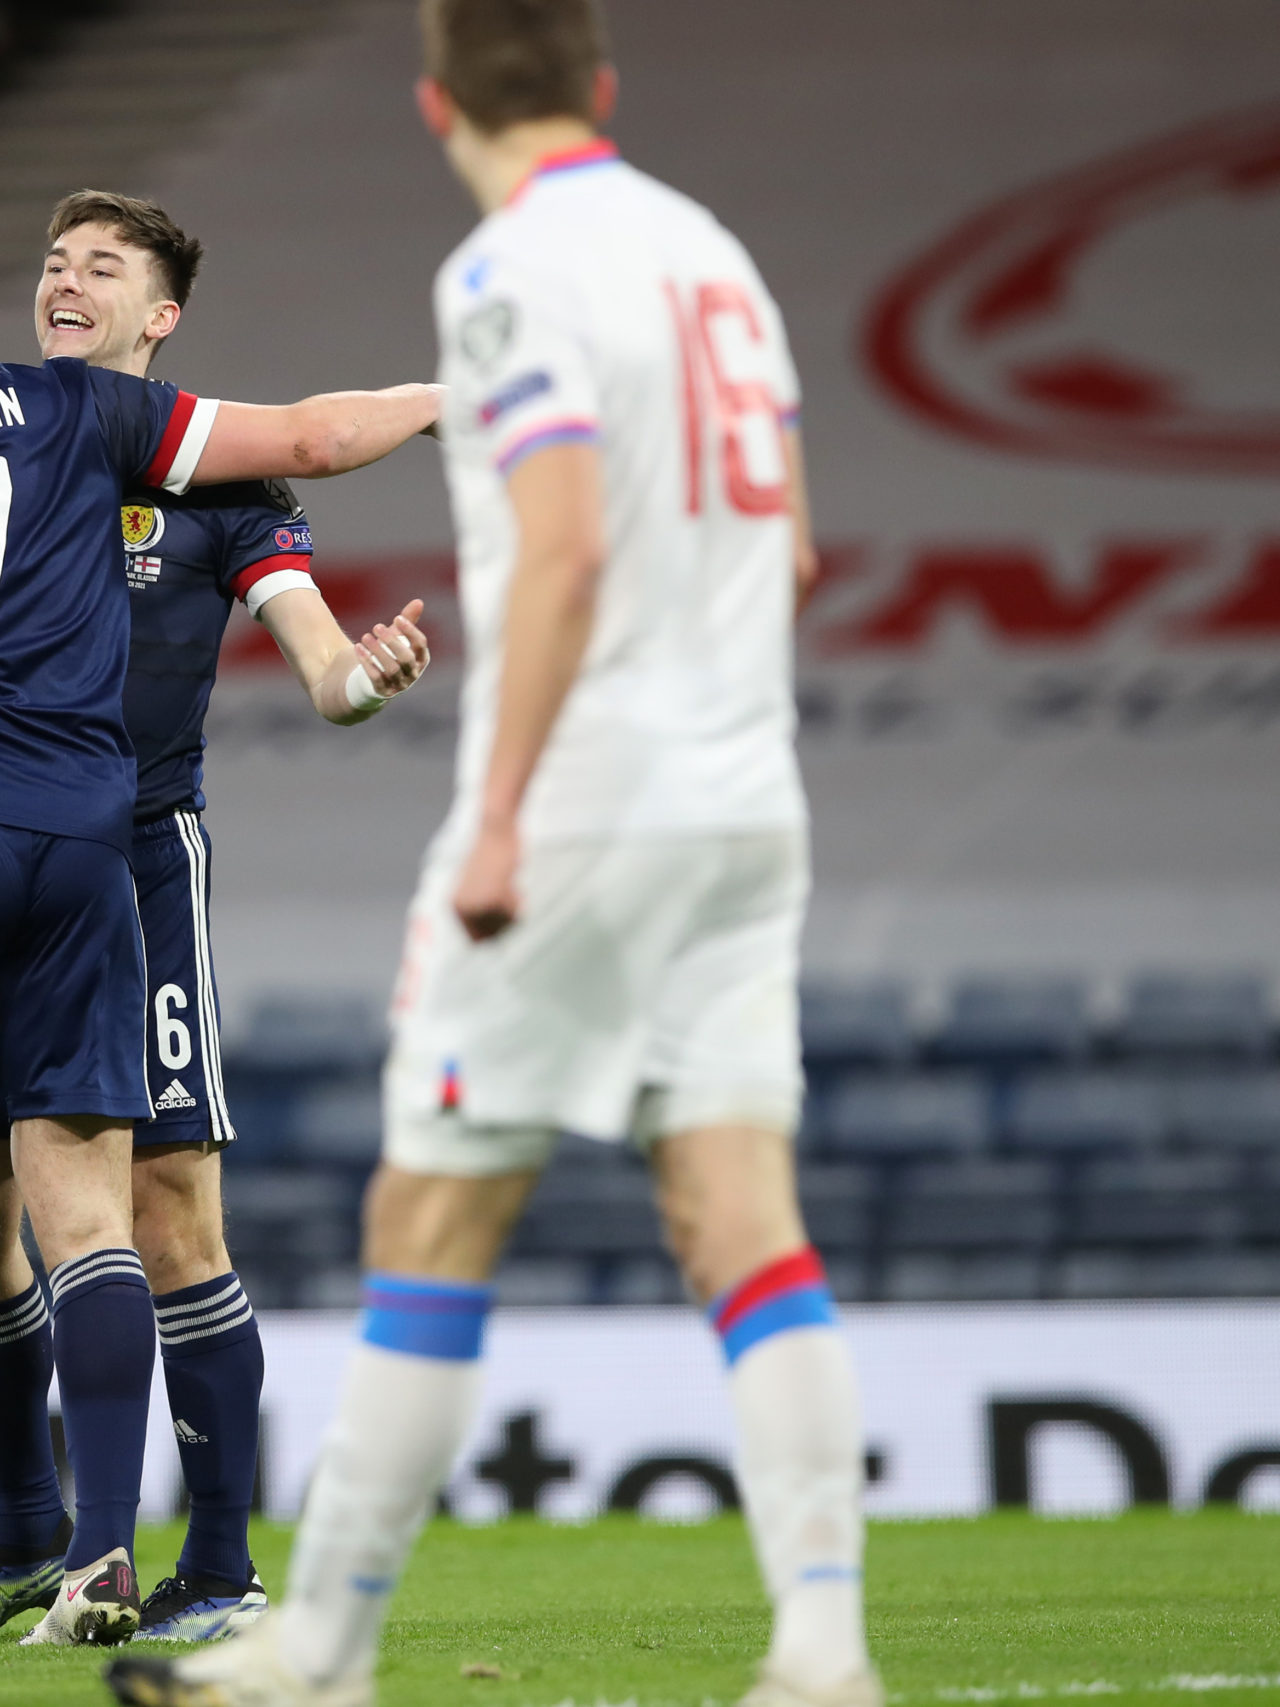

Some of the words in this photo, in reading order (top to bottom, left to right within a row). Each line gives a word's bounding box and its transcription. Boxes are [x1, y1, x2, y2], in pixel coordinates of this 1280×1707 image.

[659, 279, 792, 518] 16
[293, 532, 313, 544] RES
[154, 983, 192, 1071] 6
[155, 1097, 197, 1111] adidas
